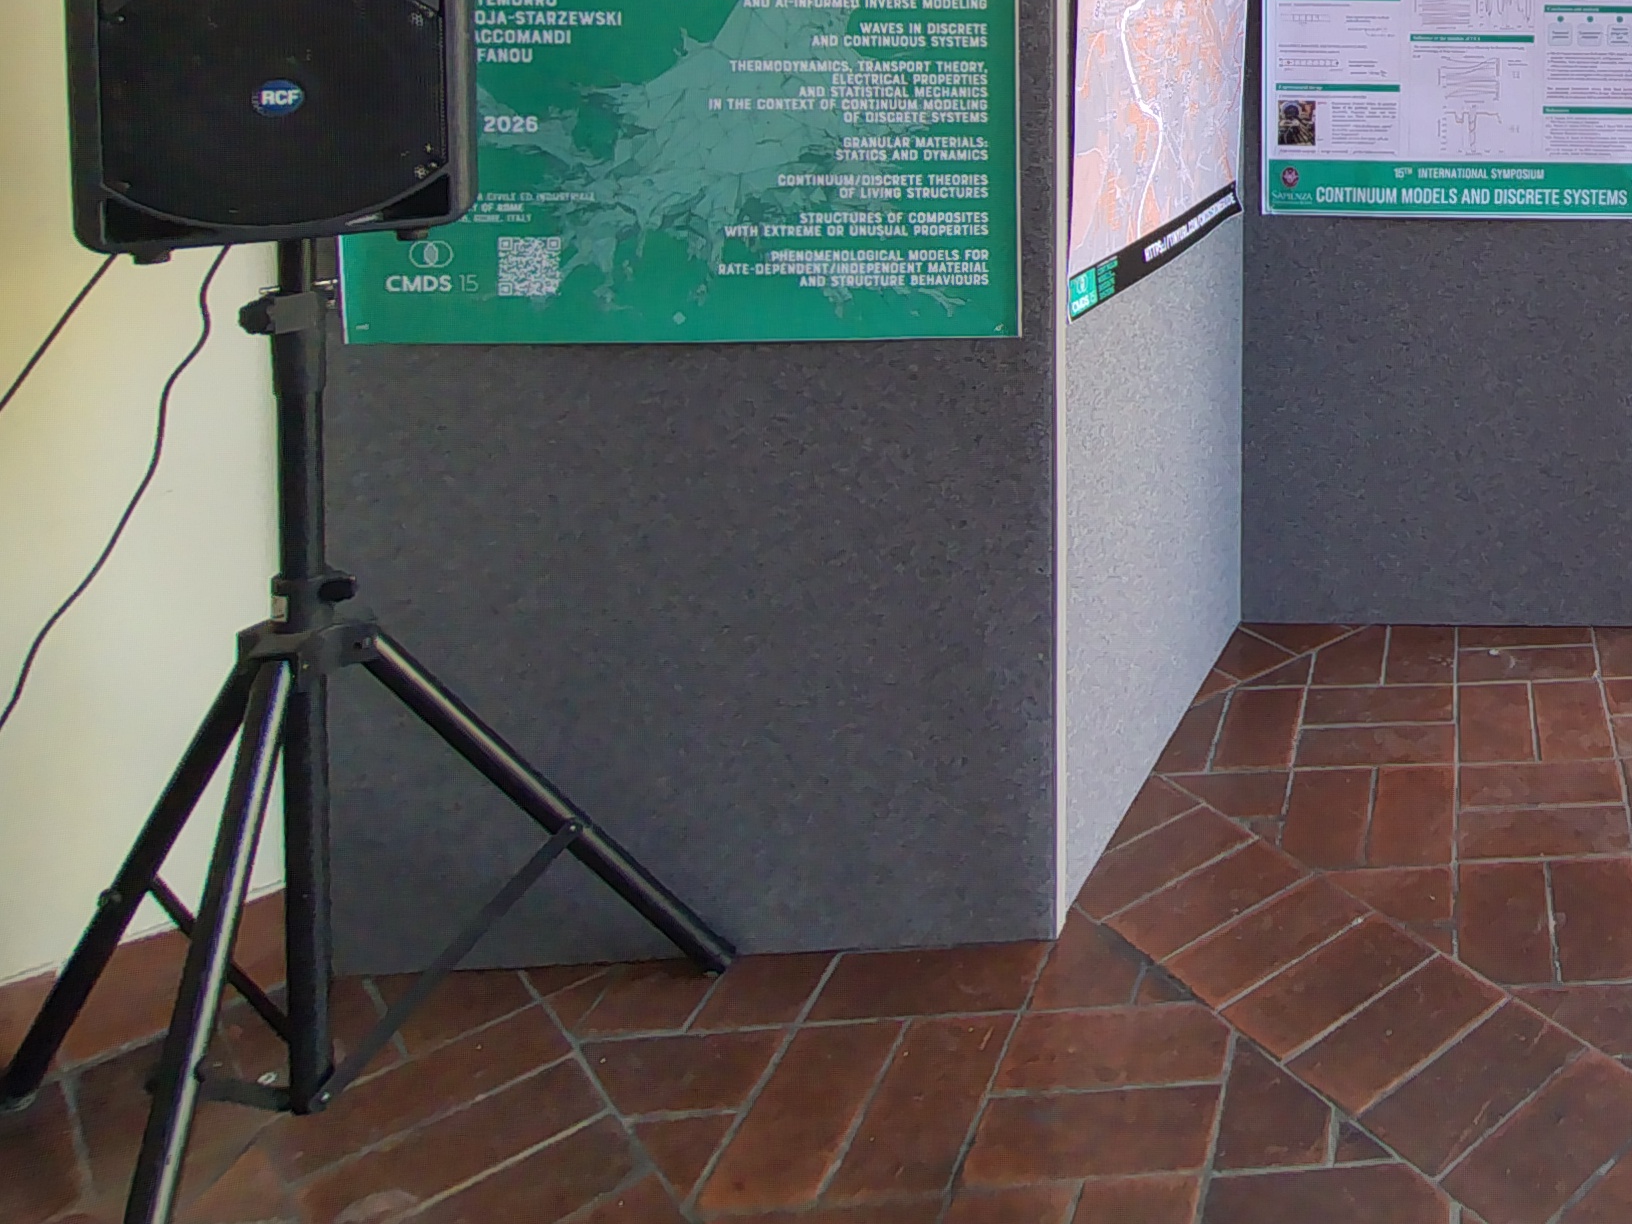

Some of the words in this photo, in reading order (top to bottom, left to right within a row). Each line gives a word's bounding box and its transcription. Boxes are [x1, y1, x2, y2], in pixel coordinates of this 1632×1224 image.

[860, 23, 903, 34] WAVES
[909, 23, 921, 34] IN
[927, 23, 987, 35] DISCRETE
[811, 35, 838, 47] AND
[844, 35, 925, 48] CONTINUOUS
[931, 36, 987, 48] SYSTEMS
[262, 89, 300, 105] RCF
[484, 116, 539, 133] 2026
[843, 137, 910, 148] GRANULAR
[916, 137, 988, 148] MATERIALS:
[835, 150, 886, 161] STATICS
[892, 149, 918, 161] AND
[923, 149, 988, 161] DYNAMICS
[1418, 168, 1488, 179] INTERNATIONAL
[1491, 169, 1544, 179] SYMPOSIUM
[1316, 187, 1396, 203] CONTINUUM
[1401, 188, 1457, 204] MODELS
[1461, 188, 1489, 204] AND
[1494, 189, 1559, 205] DISCRETE
[1564, 190, 1627, 205] SYSTEMS
[800, 212, 882, 224] STRUCTURES
[888, 213, 903, 224] OF
[908, 212, 988, 223] COMPOSITES
[725, 225, 758, 237] WITH
[764, 225, 822, 237] EXTREME
[828, 225, 844, 236] OR
[850, 225, 908, 236] UNUSUAL
[914, 225, 988, 236] PROPERTIES
[771, 250, 904, 262] PHENOMENOLOGICAL
[909, 250, 959, 261] MODELS
[966, 250, 988, 261] FOR
[386, 275, 451, 292] CMDS
[459, 275, 478, 291] 15
